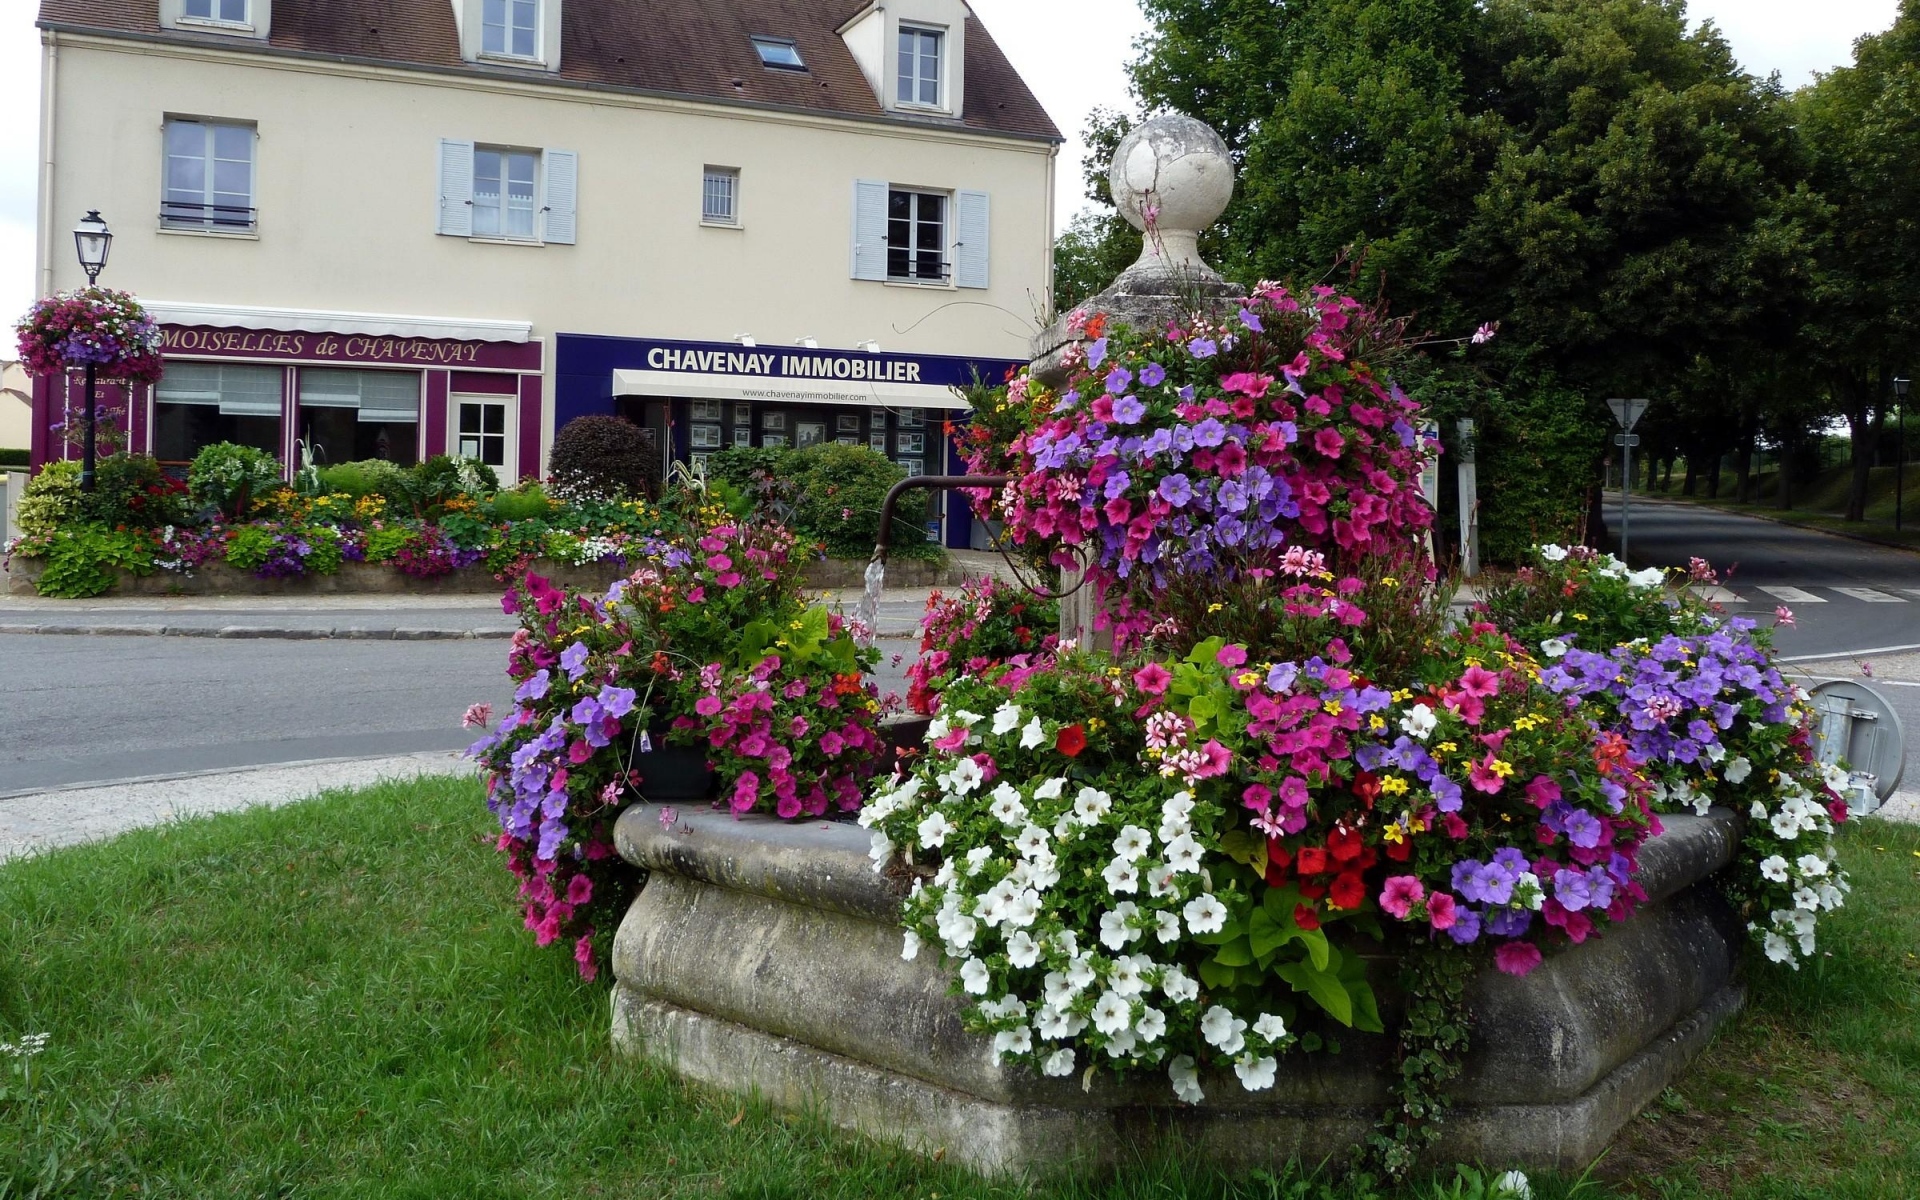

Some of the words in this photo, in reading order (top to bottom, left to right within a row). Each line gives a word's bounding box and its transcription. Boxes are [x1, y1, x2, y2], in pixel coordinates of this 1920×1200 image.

[315, 335, 338, 355] de
[345, 337, 484, 363] CHAVENAY
[647, 347, 776, 374] CHAVENAY
[781, 355, 921, 381] IMMOBILIER
[73, 376, 126, 386] Reaurant
[742, 389, 867, 401] www.chavenayimmobilier.com
